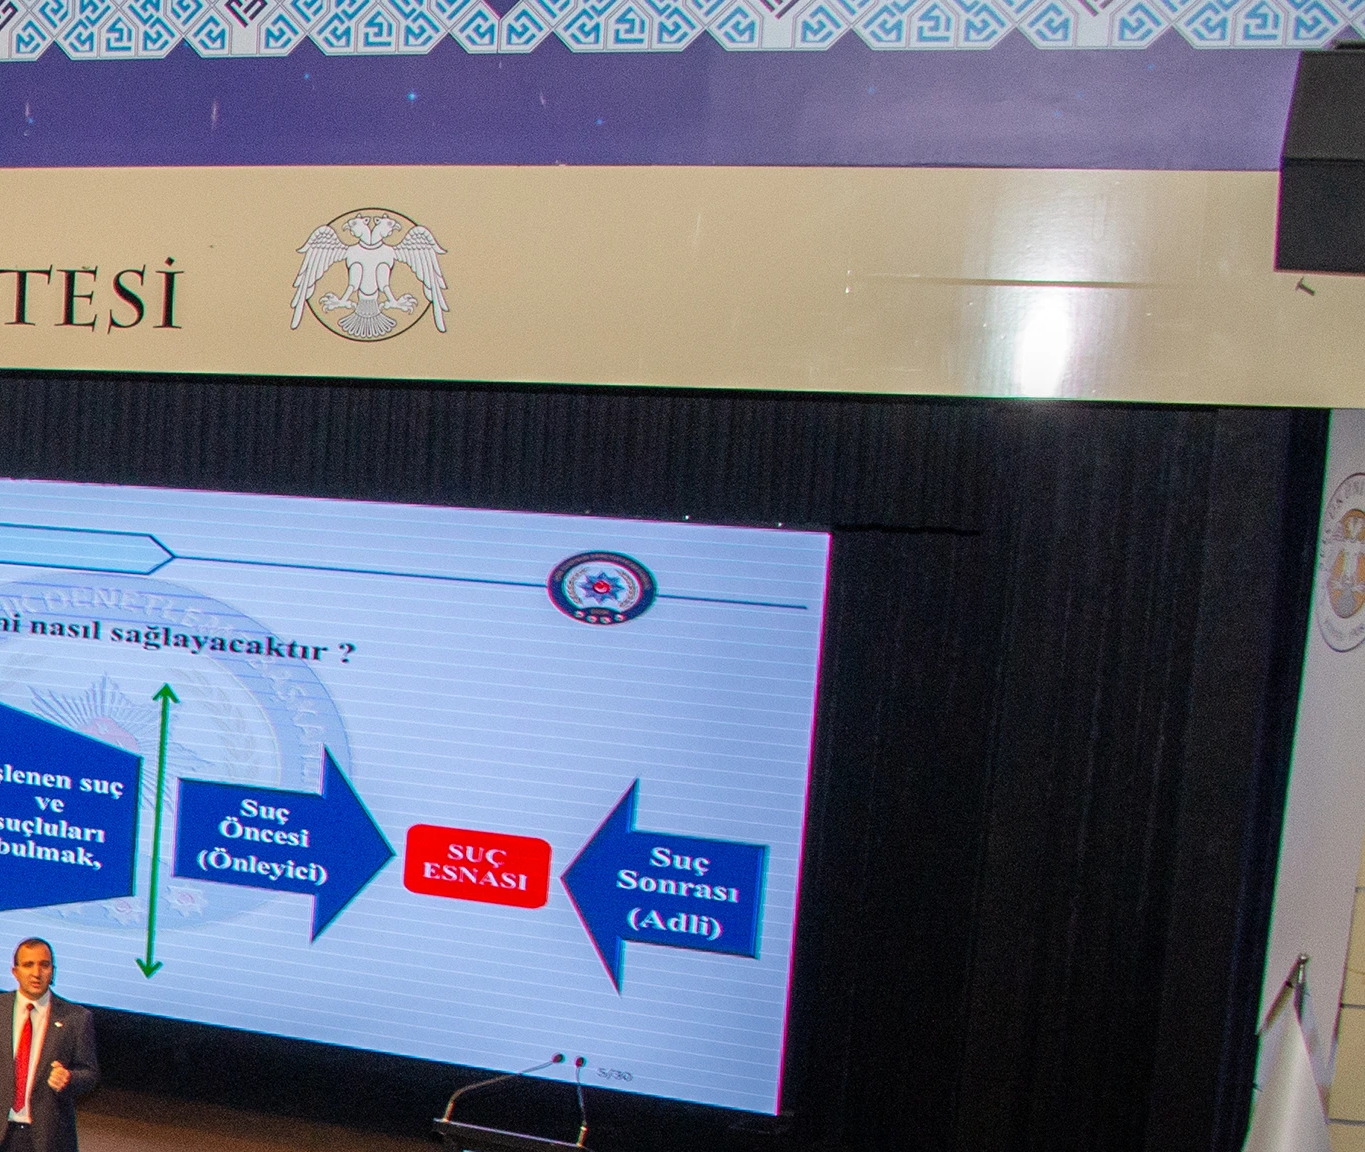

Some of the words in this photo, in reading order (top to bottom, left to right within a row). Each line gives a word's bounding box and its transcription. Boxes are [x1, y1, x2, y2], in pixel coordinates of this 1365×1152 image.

[30, 618, 102, 640] nasıl
[110, 625, 328, 661] sağlayacaktır
[79, 778, 124, 800] suç
[35, 796, 65, 813] ve
[240, 799, 290, 825] Suç
[218, 816, 310, 848] Öncesi
[196, 847, 328, 886] (Önleyici)
[447, 843, 507, 869] SUÇ
[649, 847, 711, 877] Suç
[423, 862, 528, 891] ESNASI
[616, 869, 740, 903] Sonrası
[626, 907, 725, 941] (Adli)
